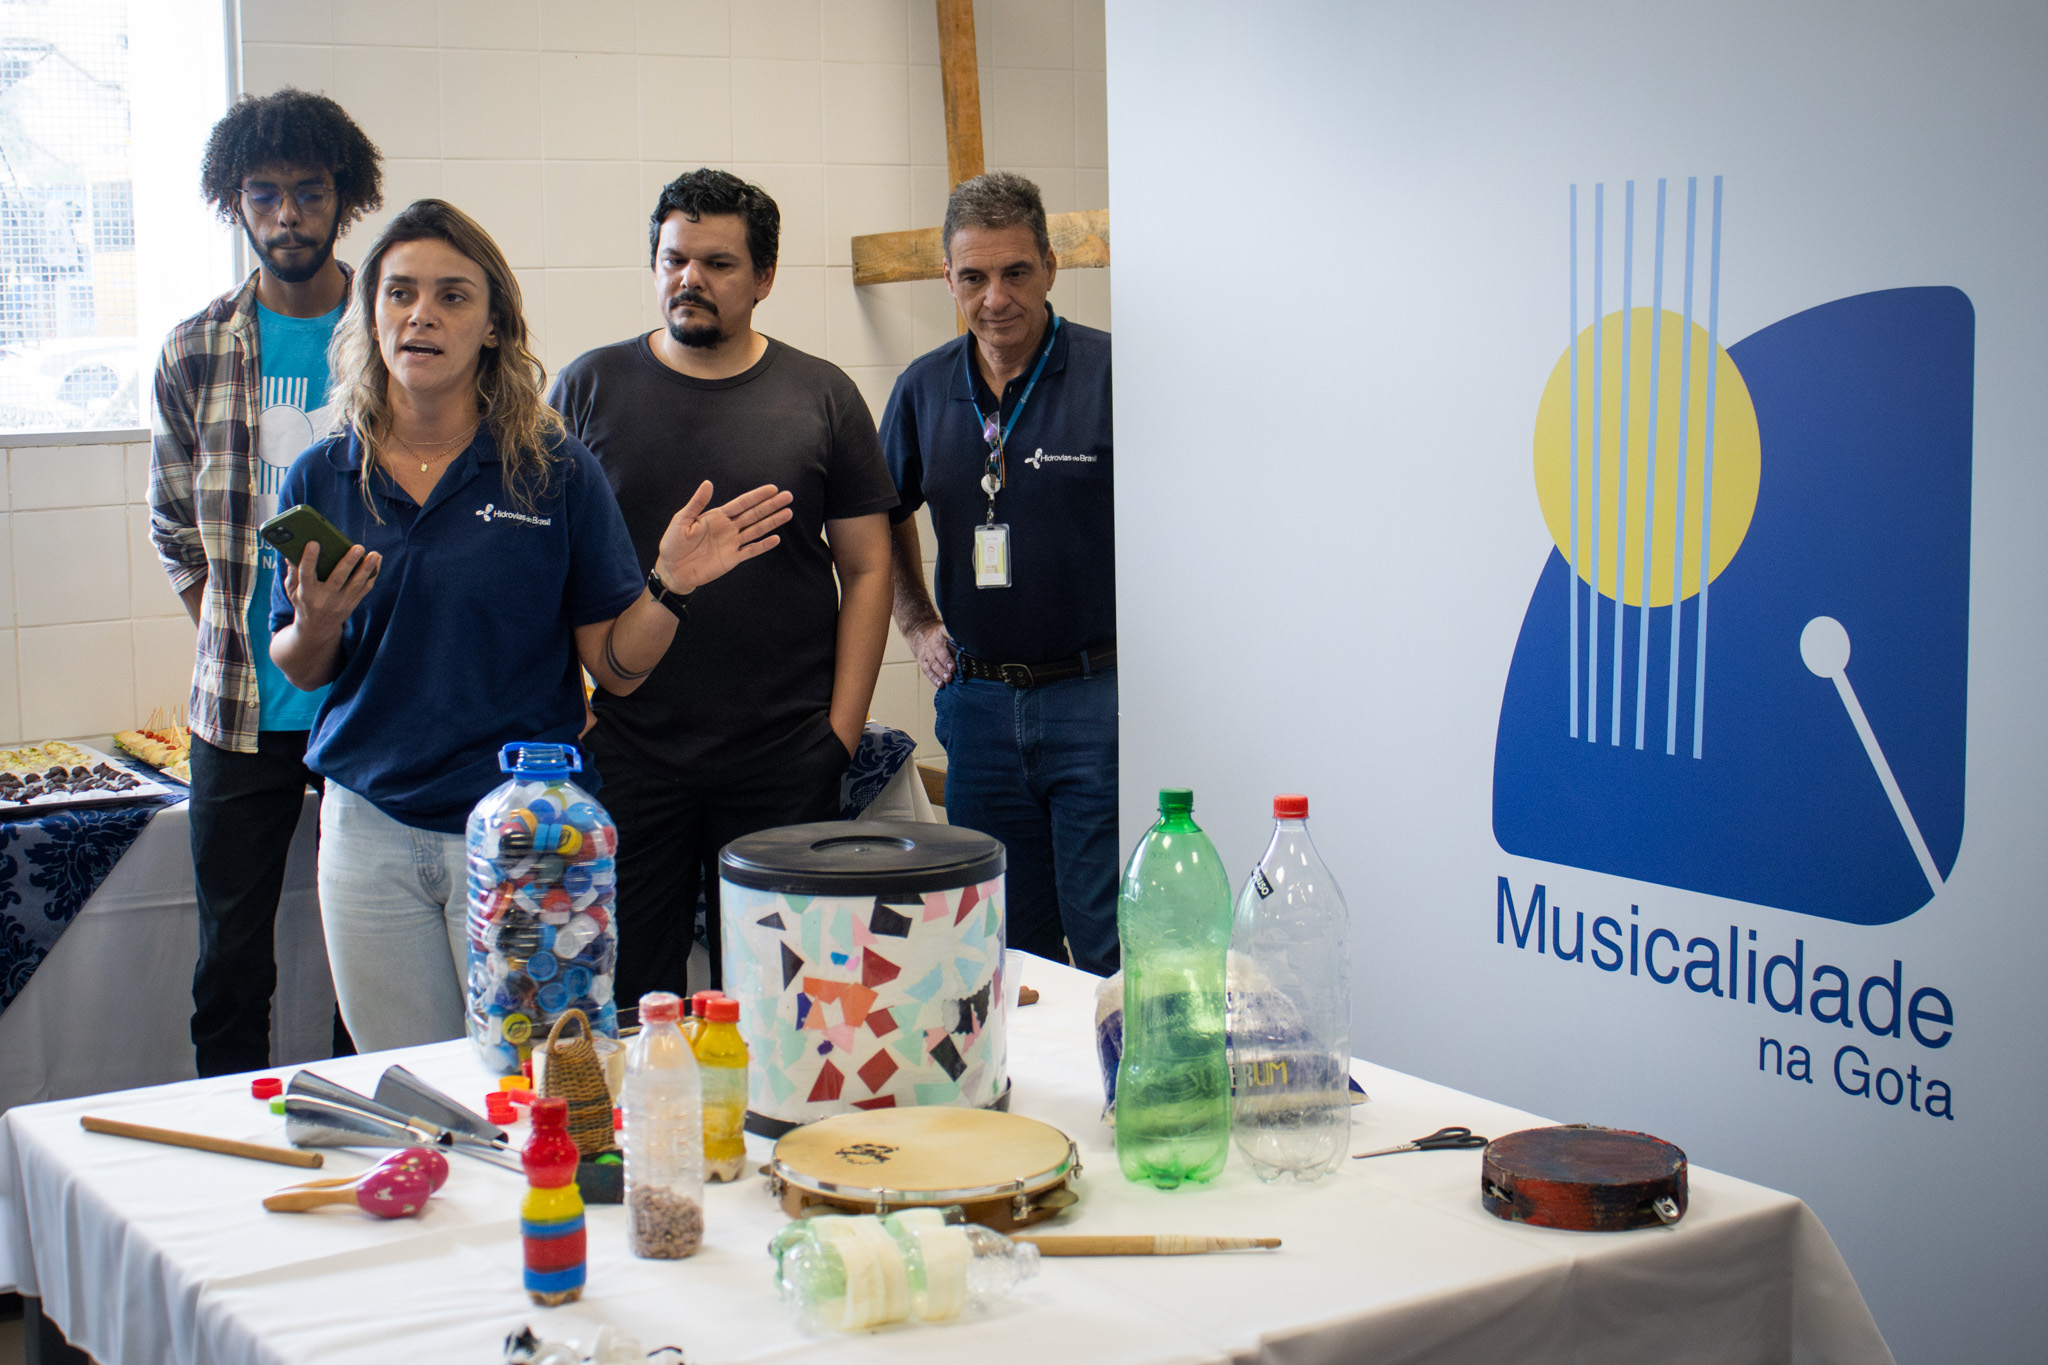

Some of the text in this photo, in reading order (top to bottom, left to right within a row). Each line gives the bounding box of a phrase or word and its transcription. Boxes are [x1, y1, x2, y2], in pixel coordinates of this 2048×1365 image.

[1040, 453, 1072, 462] Hidrovias
[493, 510, 526, 521] Hidrovias
[532, 516, 551, 526] Brasil
[1496, 875, 1955, 1049] Musicalidade
[1758, 1036, 1955, 1121] na Gota
